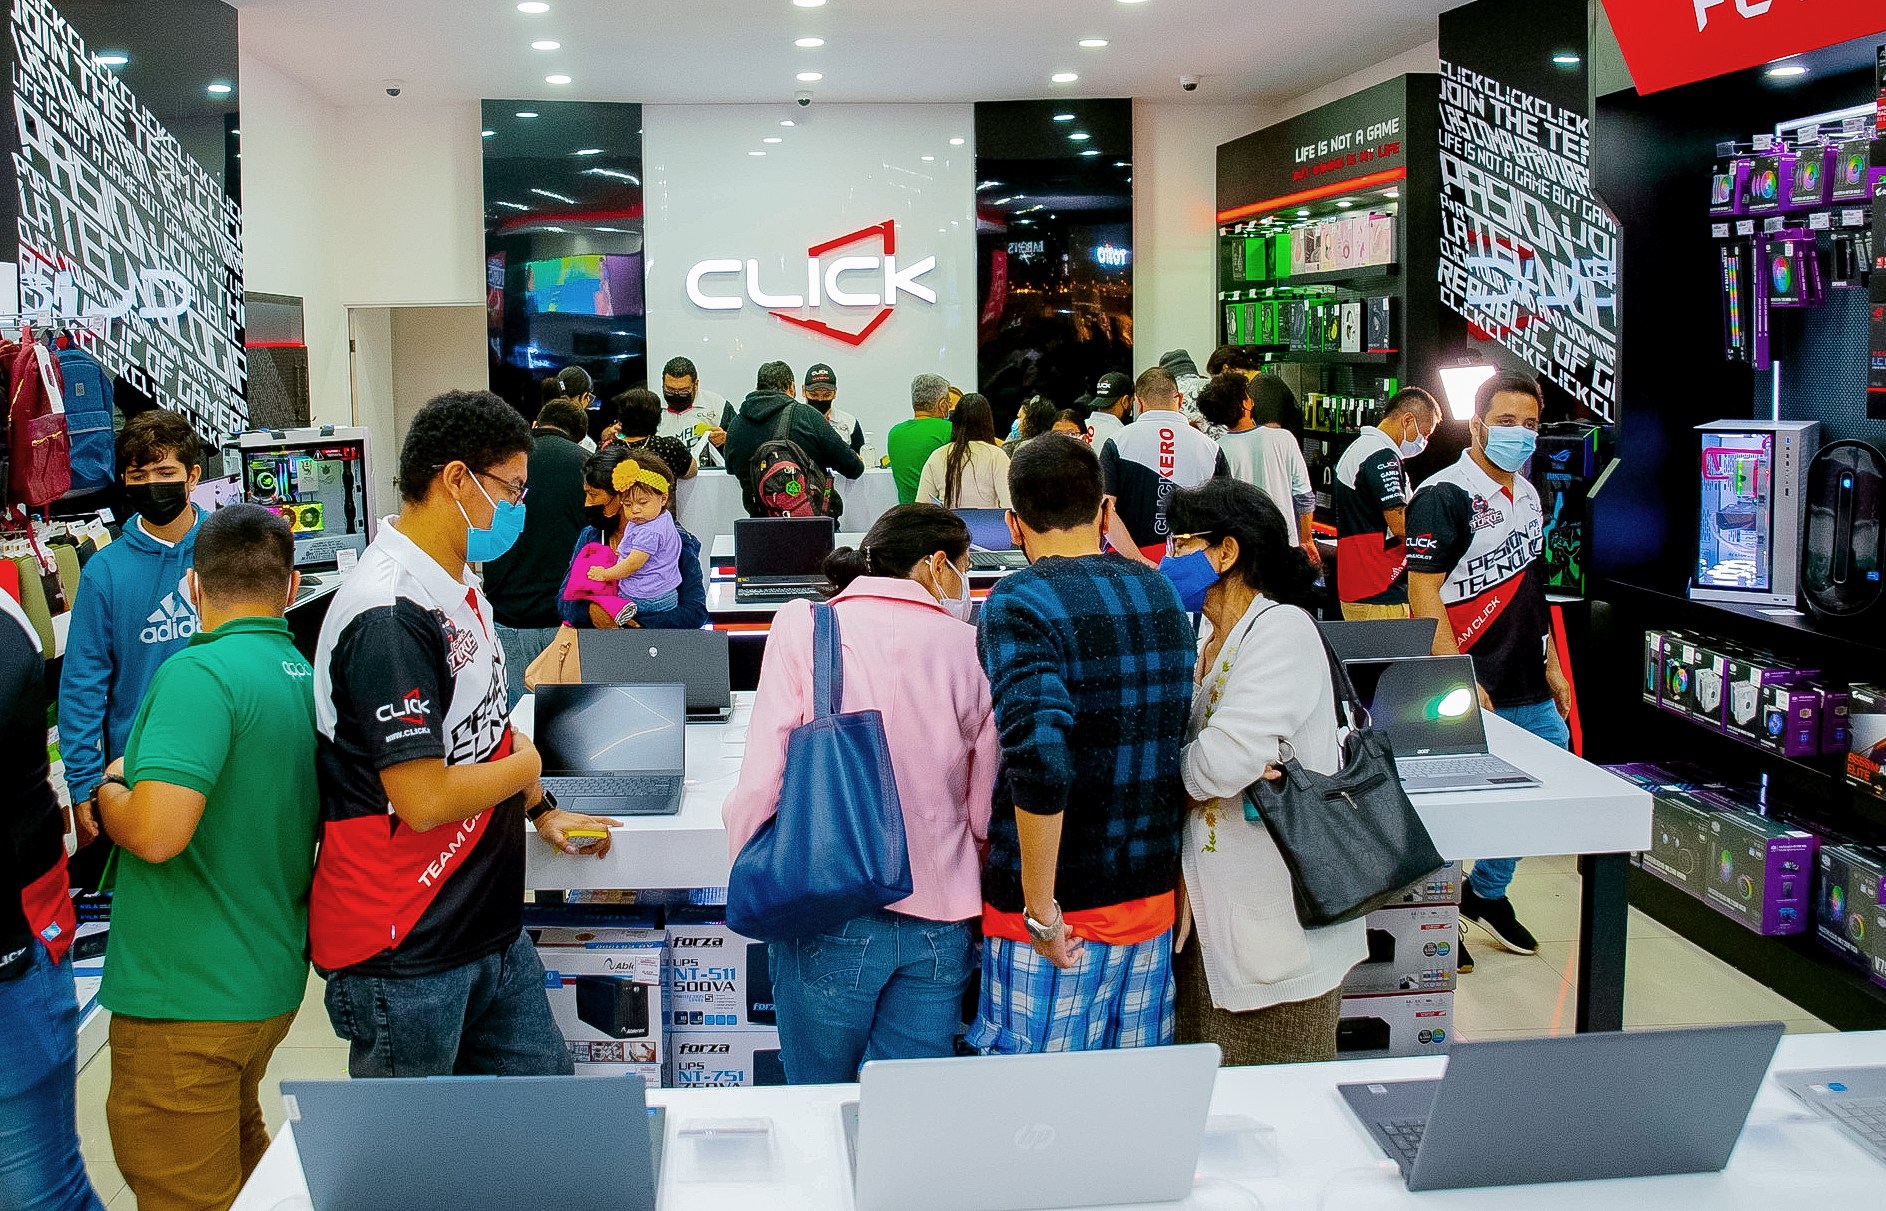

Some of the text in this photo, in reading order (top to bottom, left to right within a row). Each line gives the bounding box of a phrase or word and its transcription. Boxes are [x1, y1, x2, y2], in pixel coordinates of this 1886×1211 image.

[11, 60, 43, 112] LIFE
[73, 53, 125, 134] THE
[1439, 78, 1485, 118] JOIN
[1489, 97, 1539, 143] THE
[1296, 117, 1399, 163] LIFE IS NOT A GAME
[1439, 129, 1462, 155] LIFE
[1464, 141, 1476, 161] IS
[1477, 147, 1503, 173] NOT
[1504, 161, 1513, 180] A
[1515, 166, 1550, 200] GAME
[1552, 188, 1579, 214] BUT
[686, 254, 936, 310] CLICK
[1471, 595, 1501, 631] CLICK
[376, 698, 430, 722] CLICK
[418, 831, 467, 889] TEAM
[673, 936, 724, 948] forza
[673, 958, 699, 967] UPS
[673, 967, 736, 980] NT-511
[673, 980, 736, 992] 500VA
[679, 1043, 730, 1055] forza
[678, 1070, 744, 1082] NT-751
[679, 1062, 705, 1070] UPS
